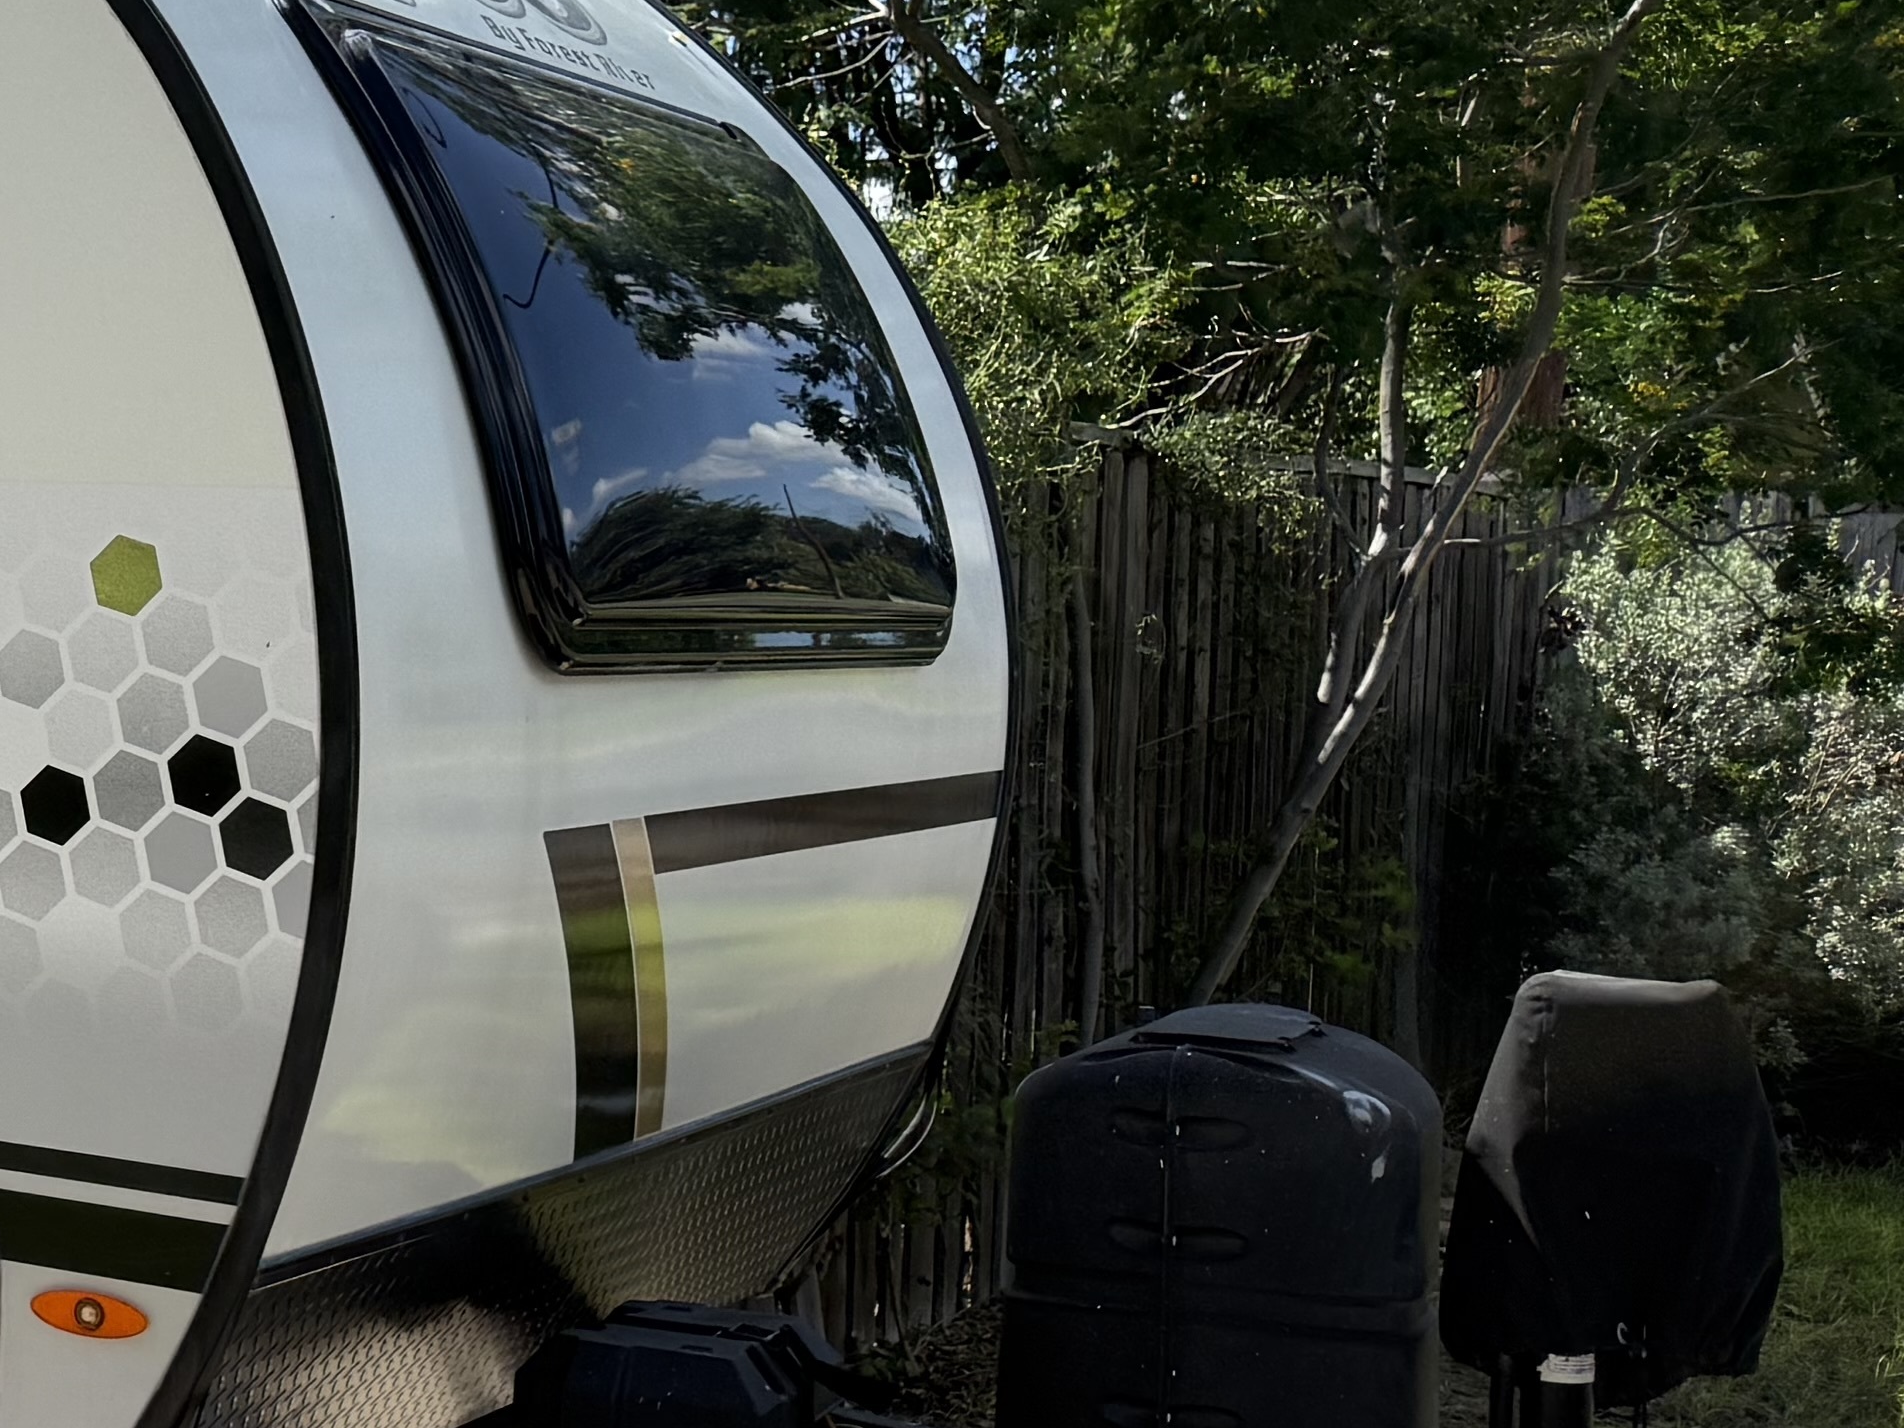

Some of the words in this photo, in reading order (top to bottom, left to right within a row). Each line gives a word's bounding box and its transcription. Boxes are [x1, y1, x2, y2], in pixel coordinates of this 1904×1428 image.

[480, 14, 526, 51] By
[516, 27, 601, 71] Forest
[593, 53, 655, 90] River
